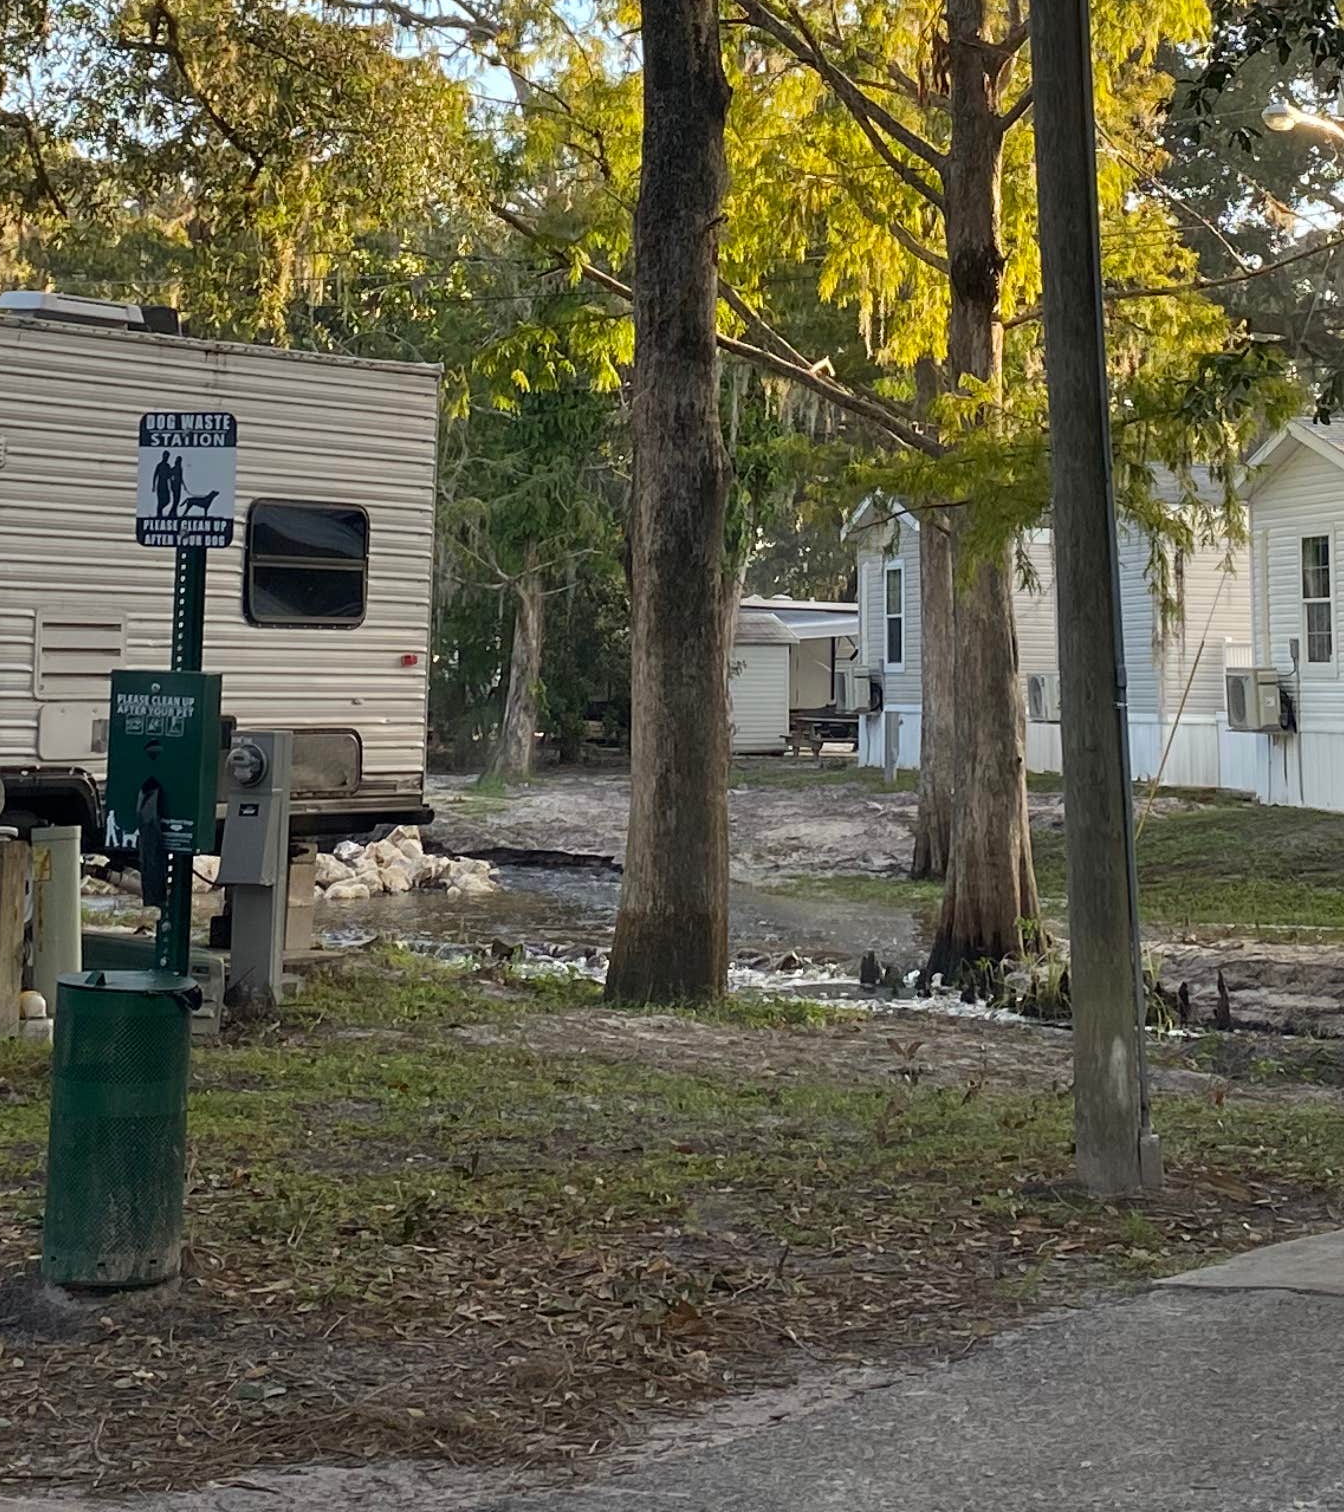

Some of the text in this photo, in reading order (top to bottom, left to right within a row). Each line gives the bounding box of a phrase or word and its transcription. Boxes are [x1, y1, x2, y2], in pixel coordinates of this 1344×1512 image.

[146, 414, 230, 430] DOG WASTE
[150, 433, 225, 447] STATION
[143, 519, 227, 533] PLEASE CLEAN UP
[144, 534, 225, 547] AFTER YOUR DOG
[117, 693, 195, 707] PLEASE CLEAN UP
[117, 705, 194, 718] AFTER YOUR PET
